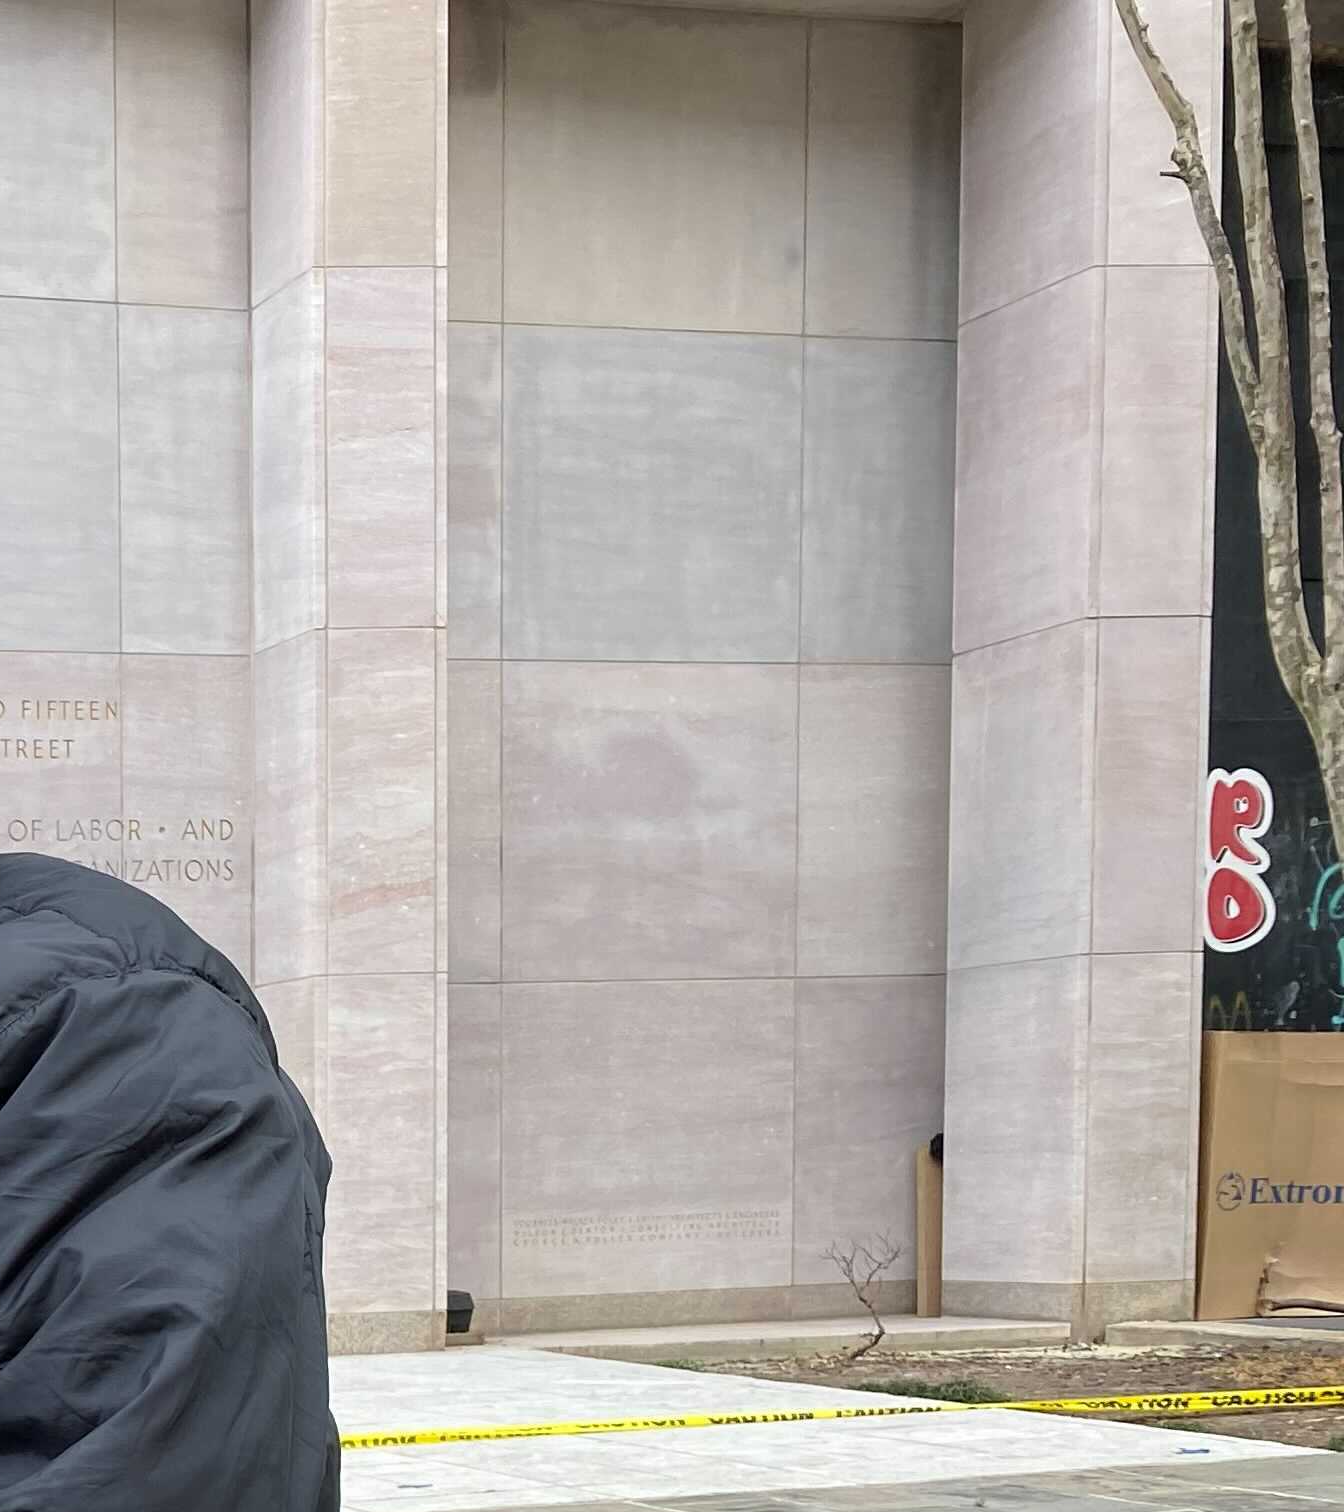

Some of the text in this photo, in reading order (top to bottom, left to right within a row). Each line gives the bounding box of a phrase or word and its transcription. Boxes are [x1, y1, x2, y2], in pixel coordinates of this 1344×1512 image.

[21, 699, 118, 721] FIFTEEN
[7, 818, 233, 842] OF LABOR AND
[73, 859, 234, 882] ANIZATIONS
